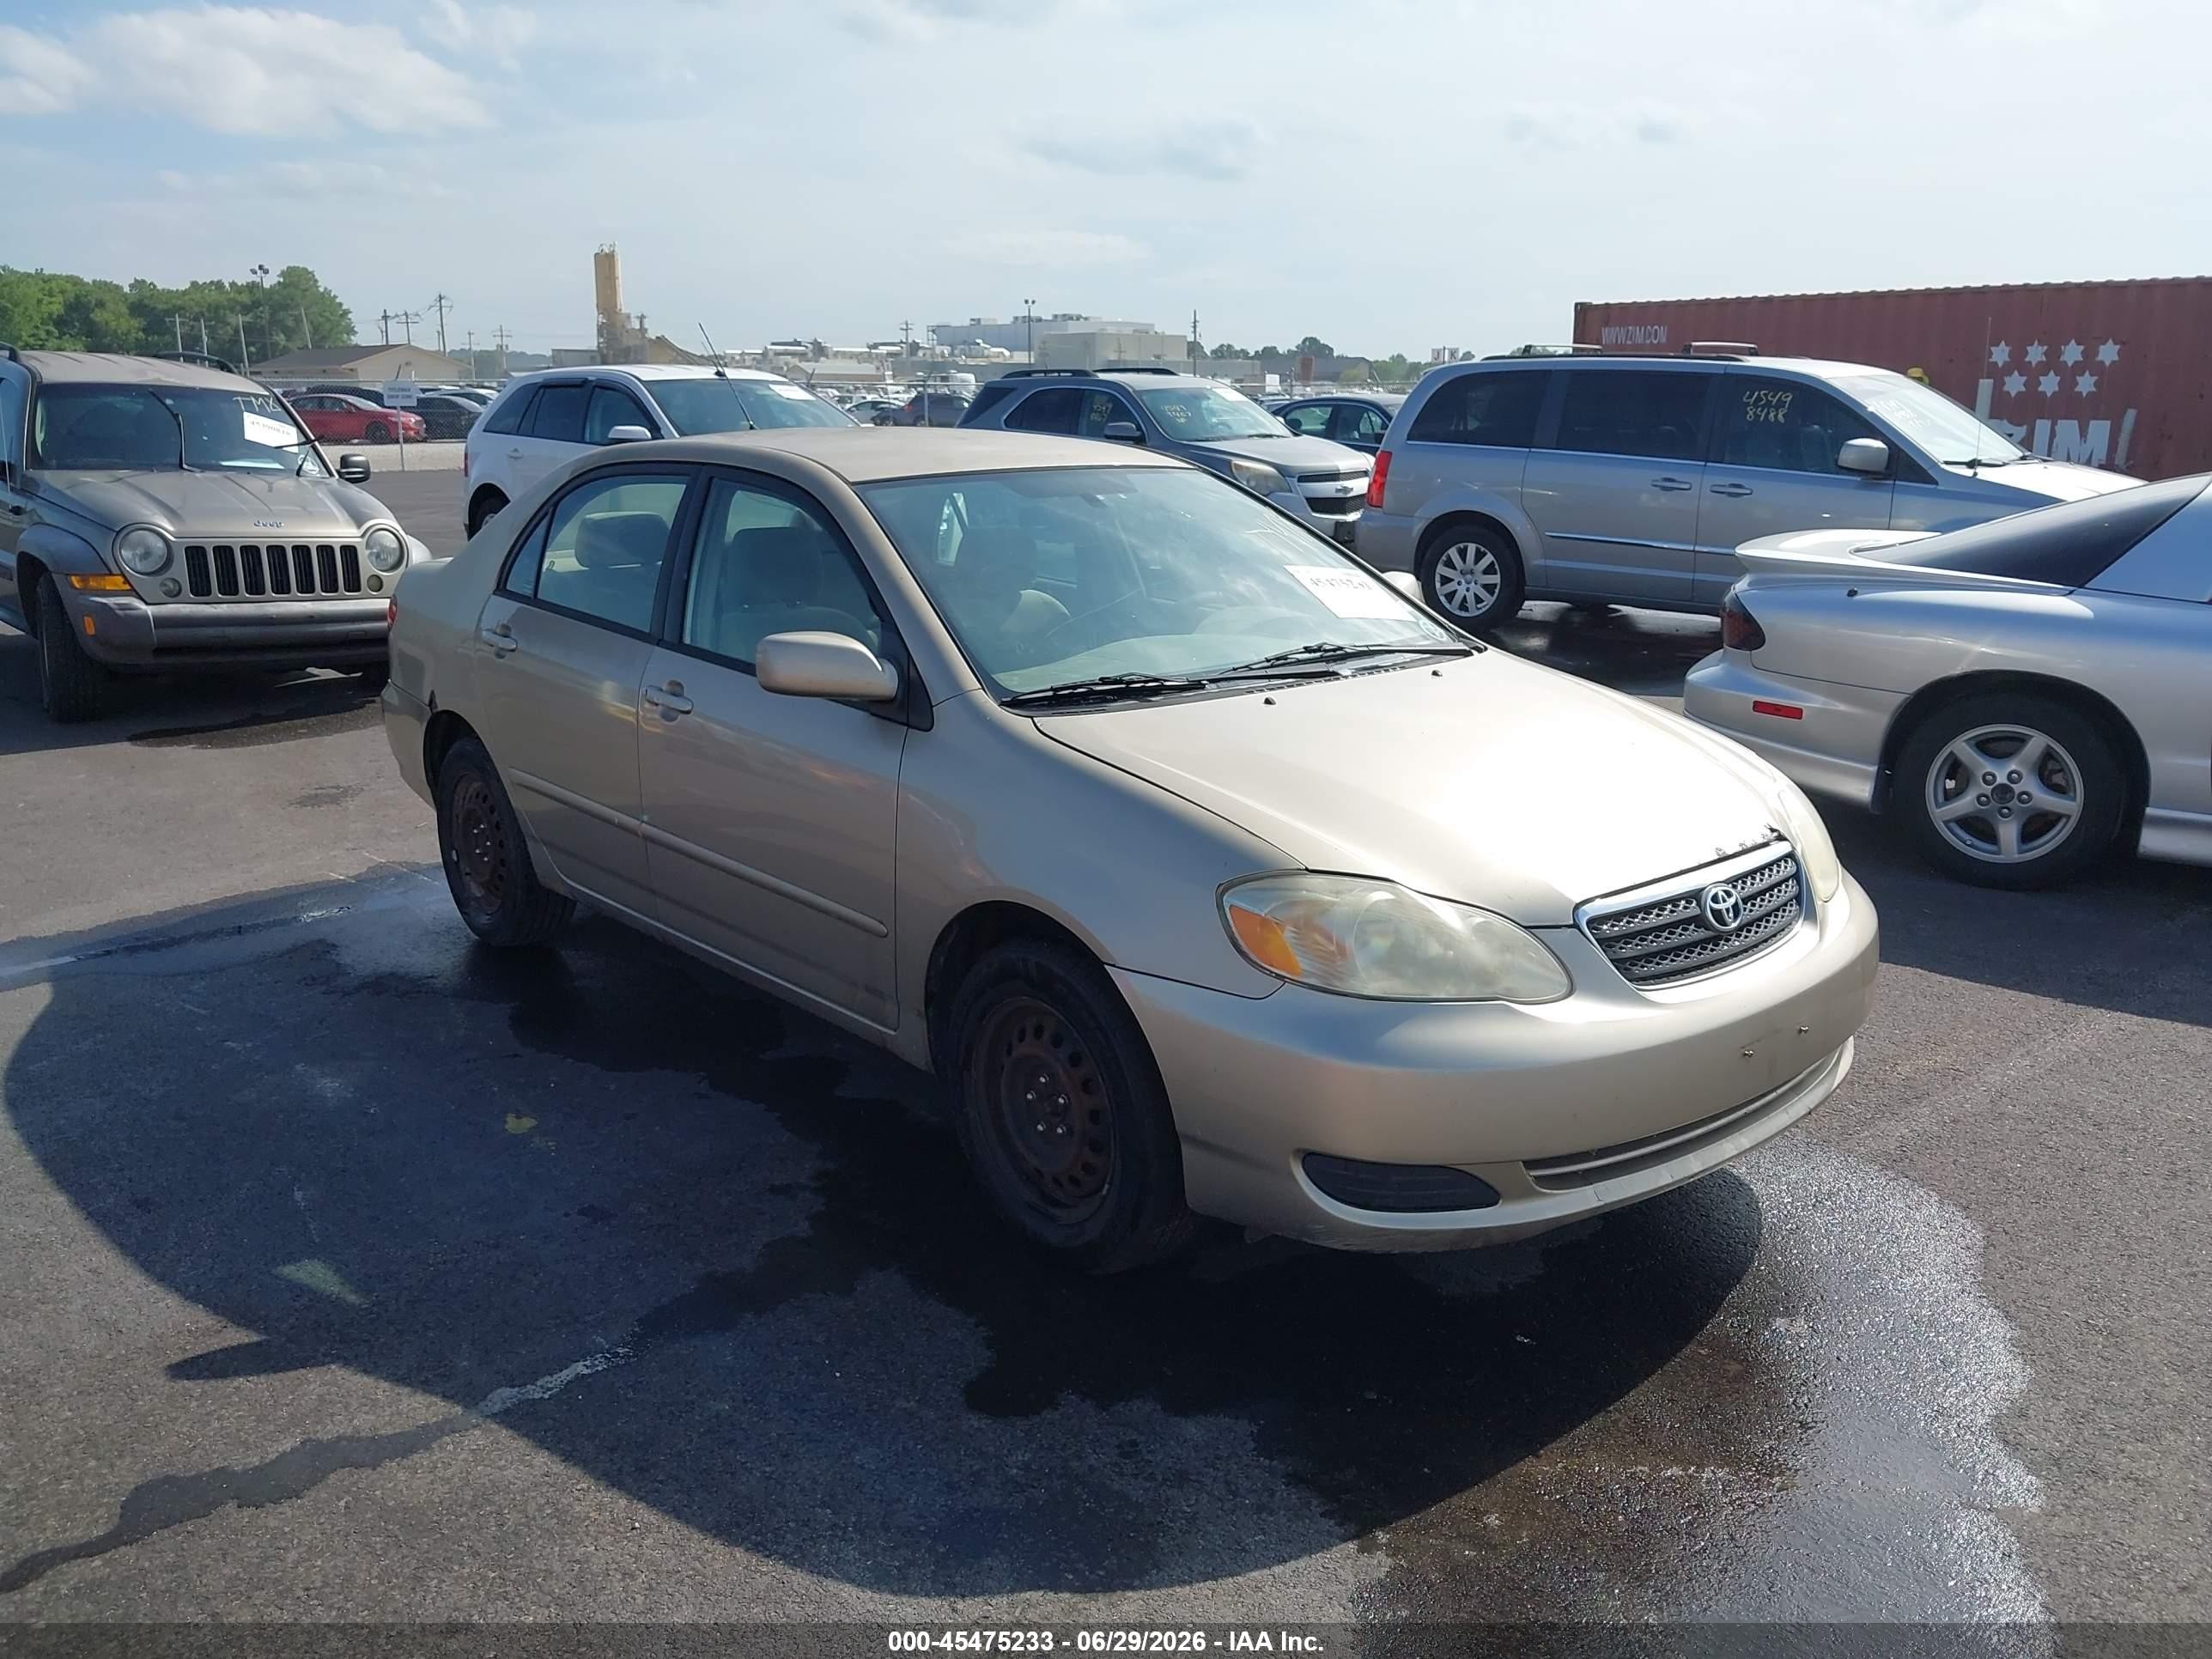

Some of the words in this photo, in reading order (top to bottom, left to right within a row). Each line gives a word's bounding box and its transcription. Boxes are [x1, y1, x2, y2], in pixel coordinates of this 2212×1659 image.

[1449, 349, 1457, 361] K
[1743, 390, 1793, 408] 4549
[1747, 405, 1787, 423] 8488
